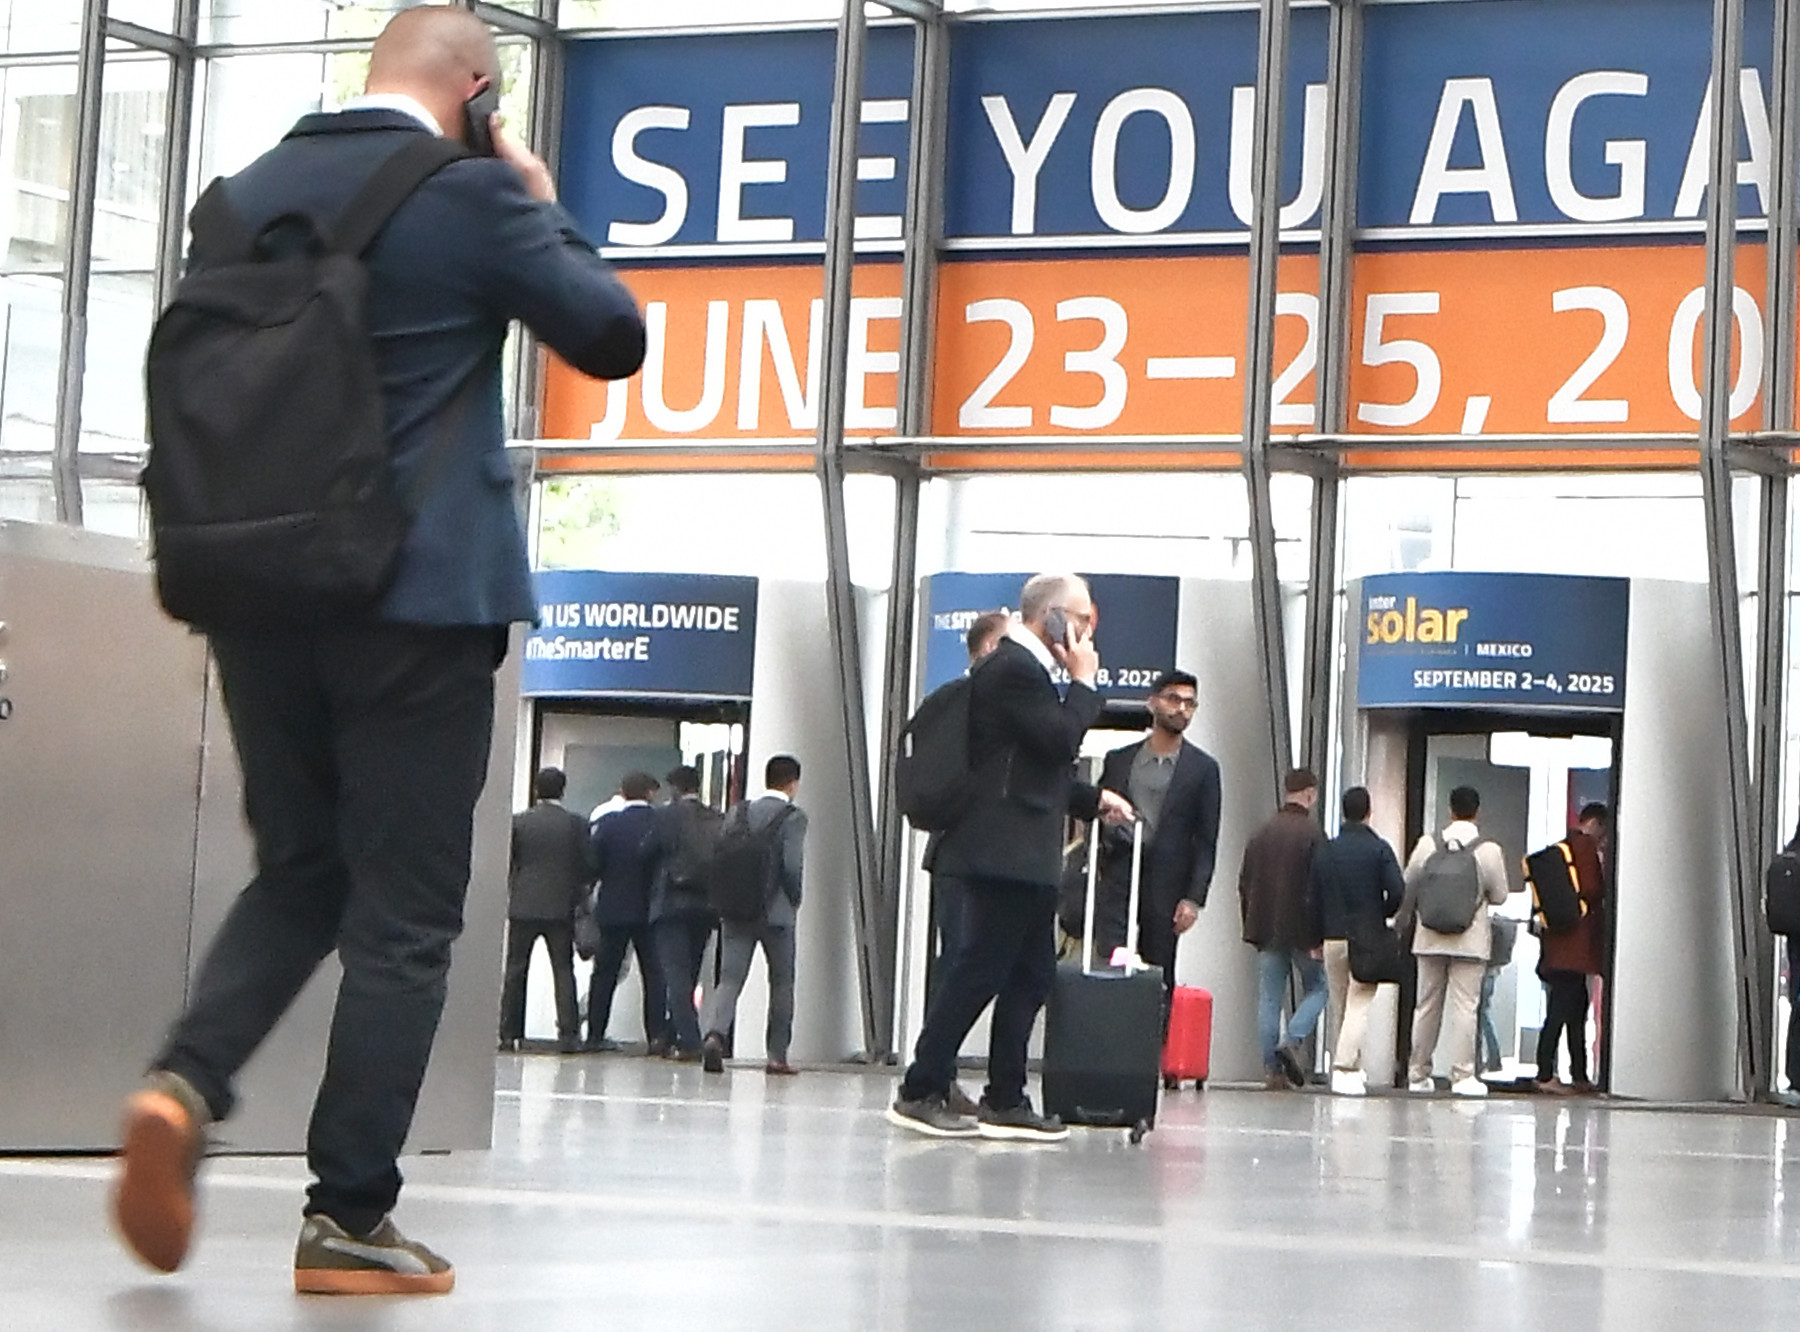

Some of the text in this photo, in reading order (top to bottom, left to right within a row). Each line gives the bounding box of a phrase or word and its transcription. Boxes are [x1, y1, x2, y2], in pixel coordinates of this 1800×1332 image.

[607, 100, 910, 246] SEE
[981, 84, 1329, 233] YOU
[556, 603, 580, 628] US
[584, 603, 740, 632] WORLDWIDE
[1367, 596, 1469, 644] solar
[1476, 642, 1533, 658] MEXICO
[1413, 669, 1517, 690] SEPTEMBER
[1567, 674, 1615, 694] 2025
